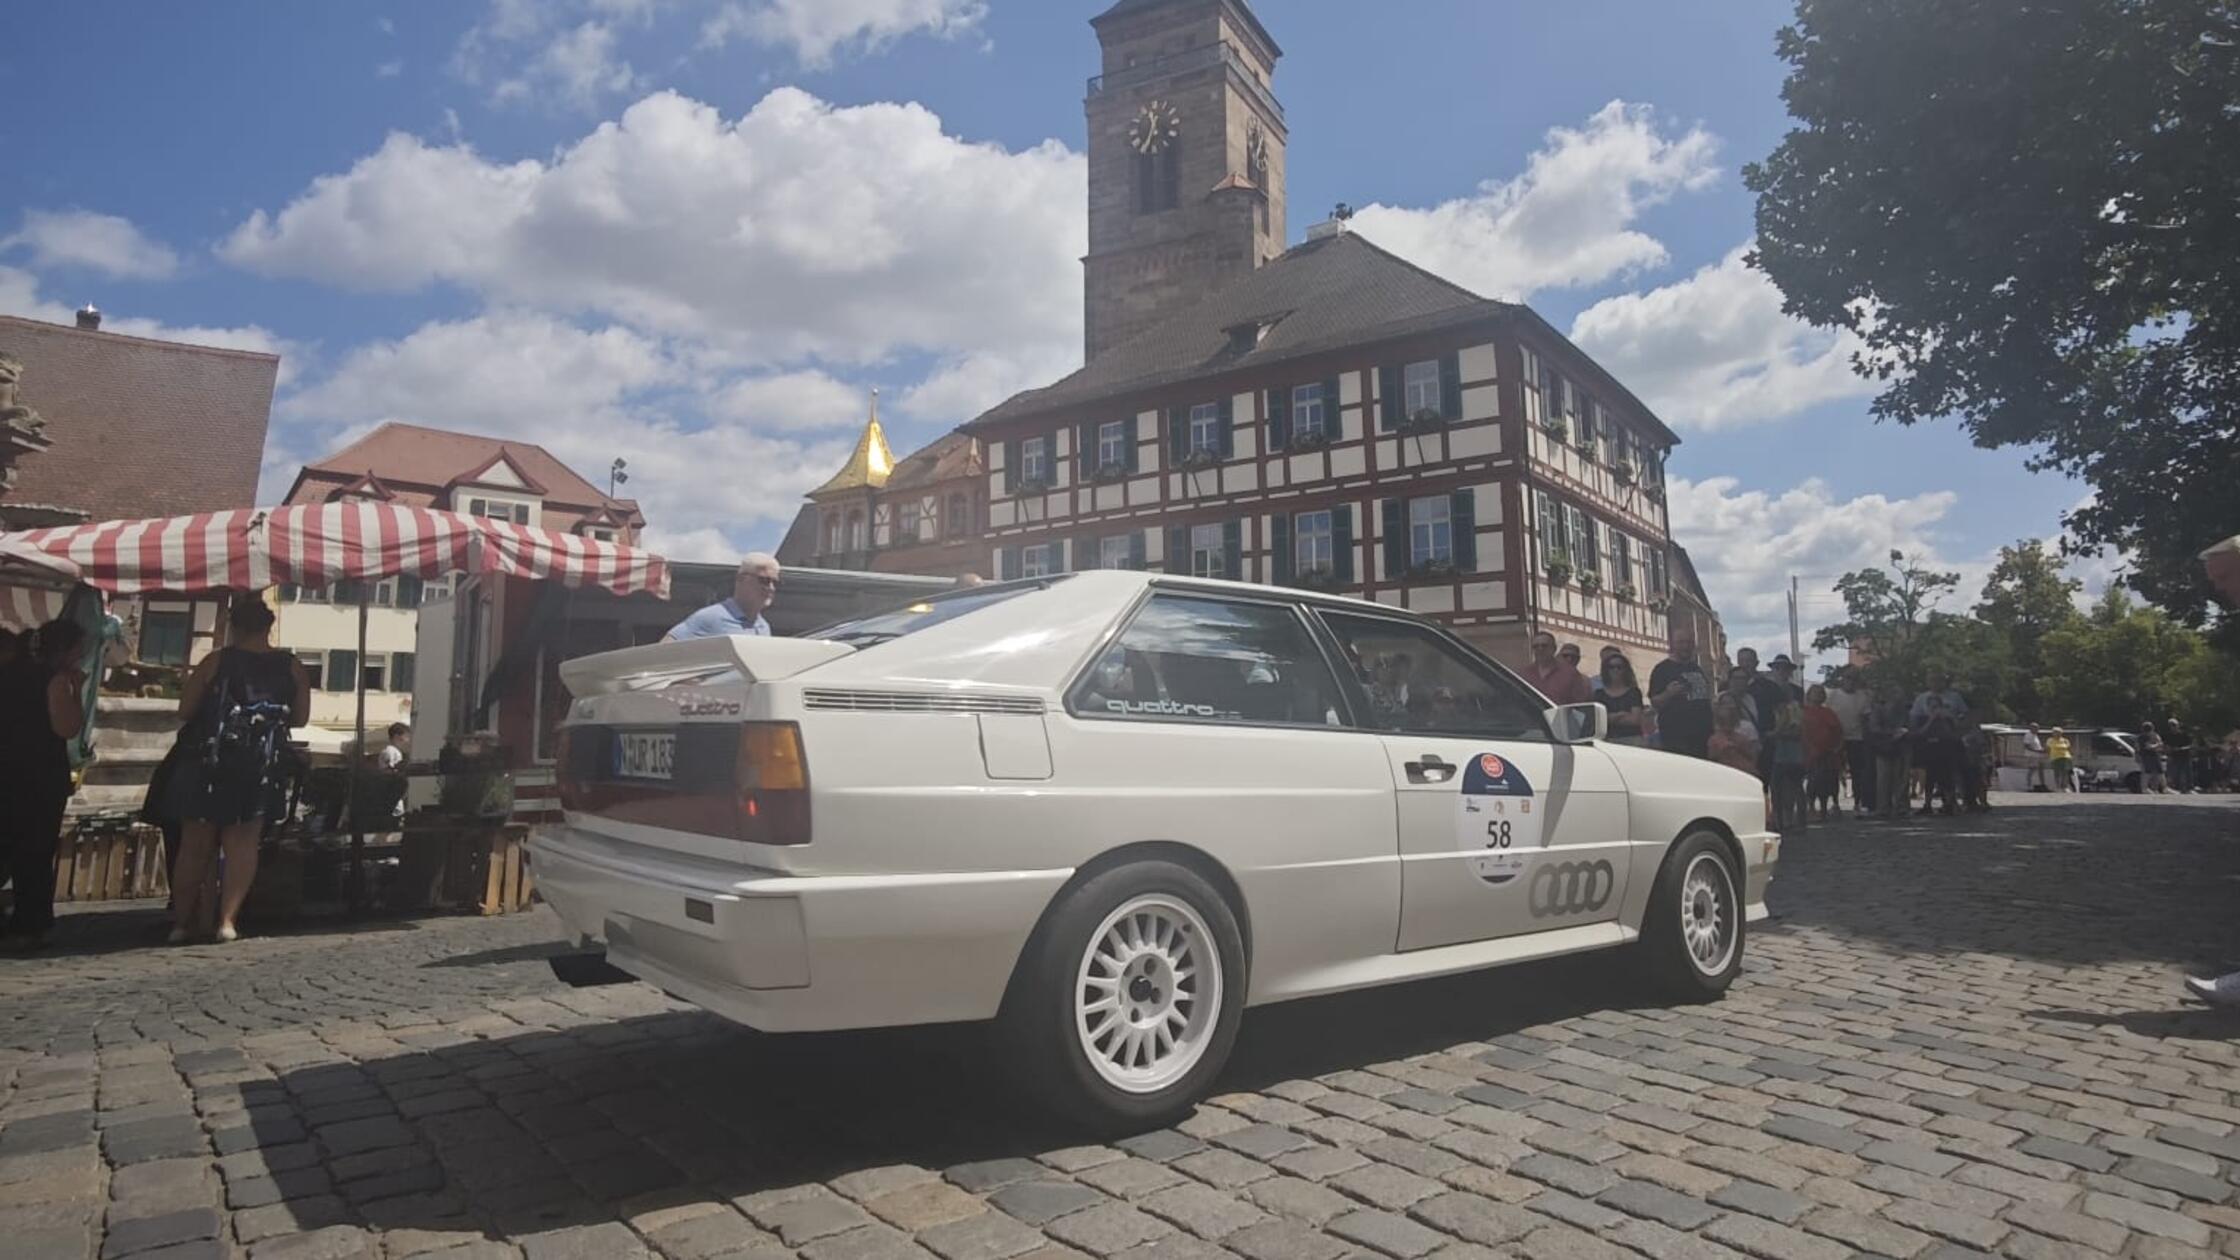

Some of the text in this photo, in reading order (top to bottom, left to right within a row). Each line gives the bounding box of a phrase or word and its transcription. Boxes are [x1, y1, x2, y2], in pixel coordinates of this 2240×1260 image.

[680, 702, 740, 717] quattro
[1106, 700, 1214, 715] quattro
[1486, 820, 1511, 848] 58
